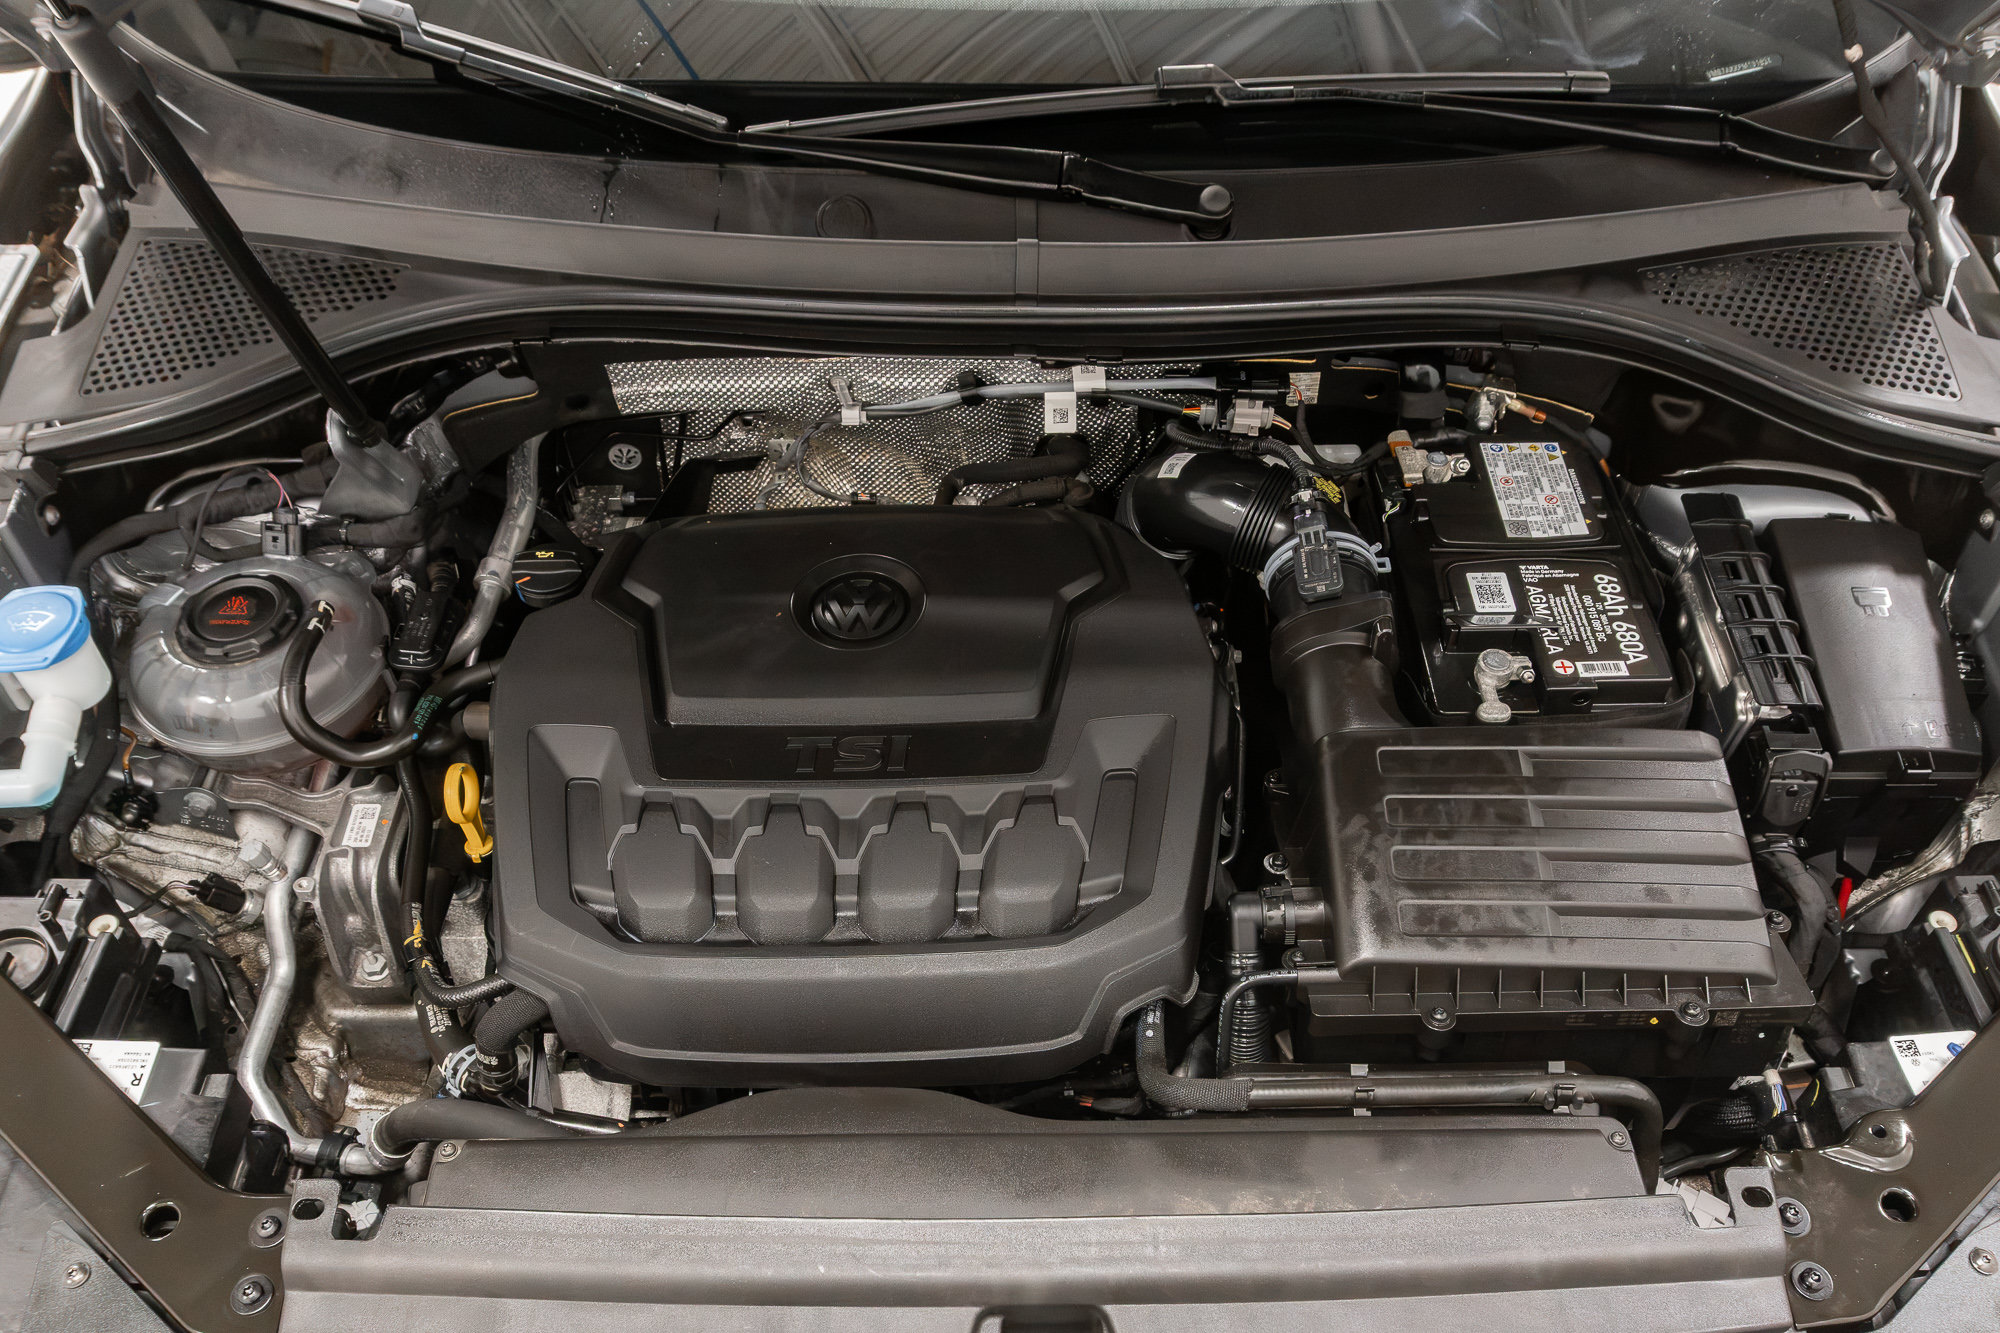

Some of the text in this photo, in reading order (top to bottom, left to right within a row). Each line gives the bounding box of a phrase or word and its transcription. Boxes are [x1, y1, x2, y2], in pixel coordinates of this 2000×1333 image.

[1568, 468, 1580, 487] DANGER
[1582, 595, 1594, 606] 000
[1525, 585, 1564, 654] AGM/RLA
[1587, 607, 1599, 618] 915
[1593, 574, 1648, 664] 68Ah 680A
[1596, 632, 1607, 642] BC
[785, 735, 912, 772] TSI
[130, 1073, 144, 1086] R
